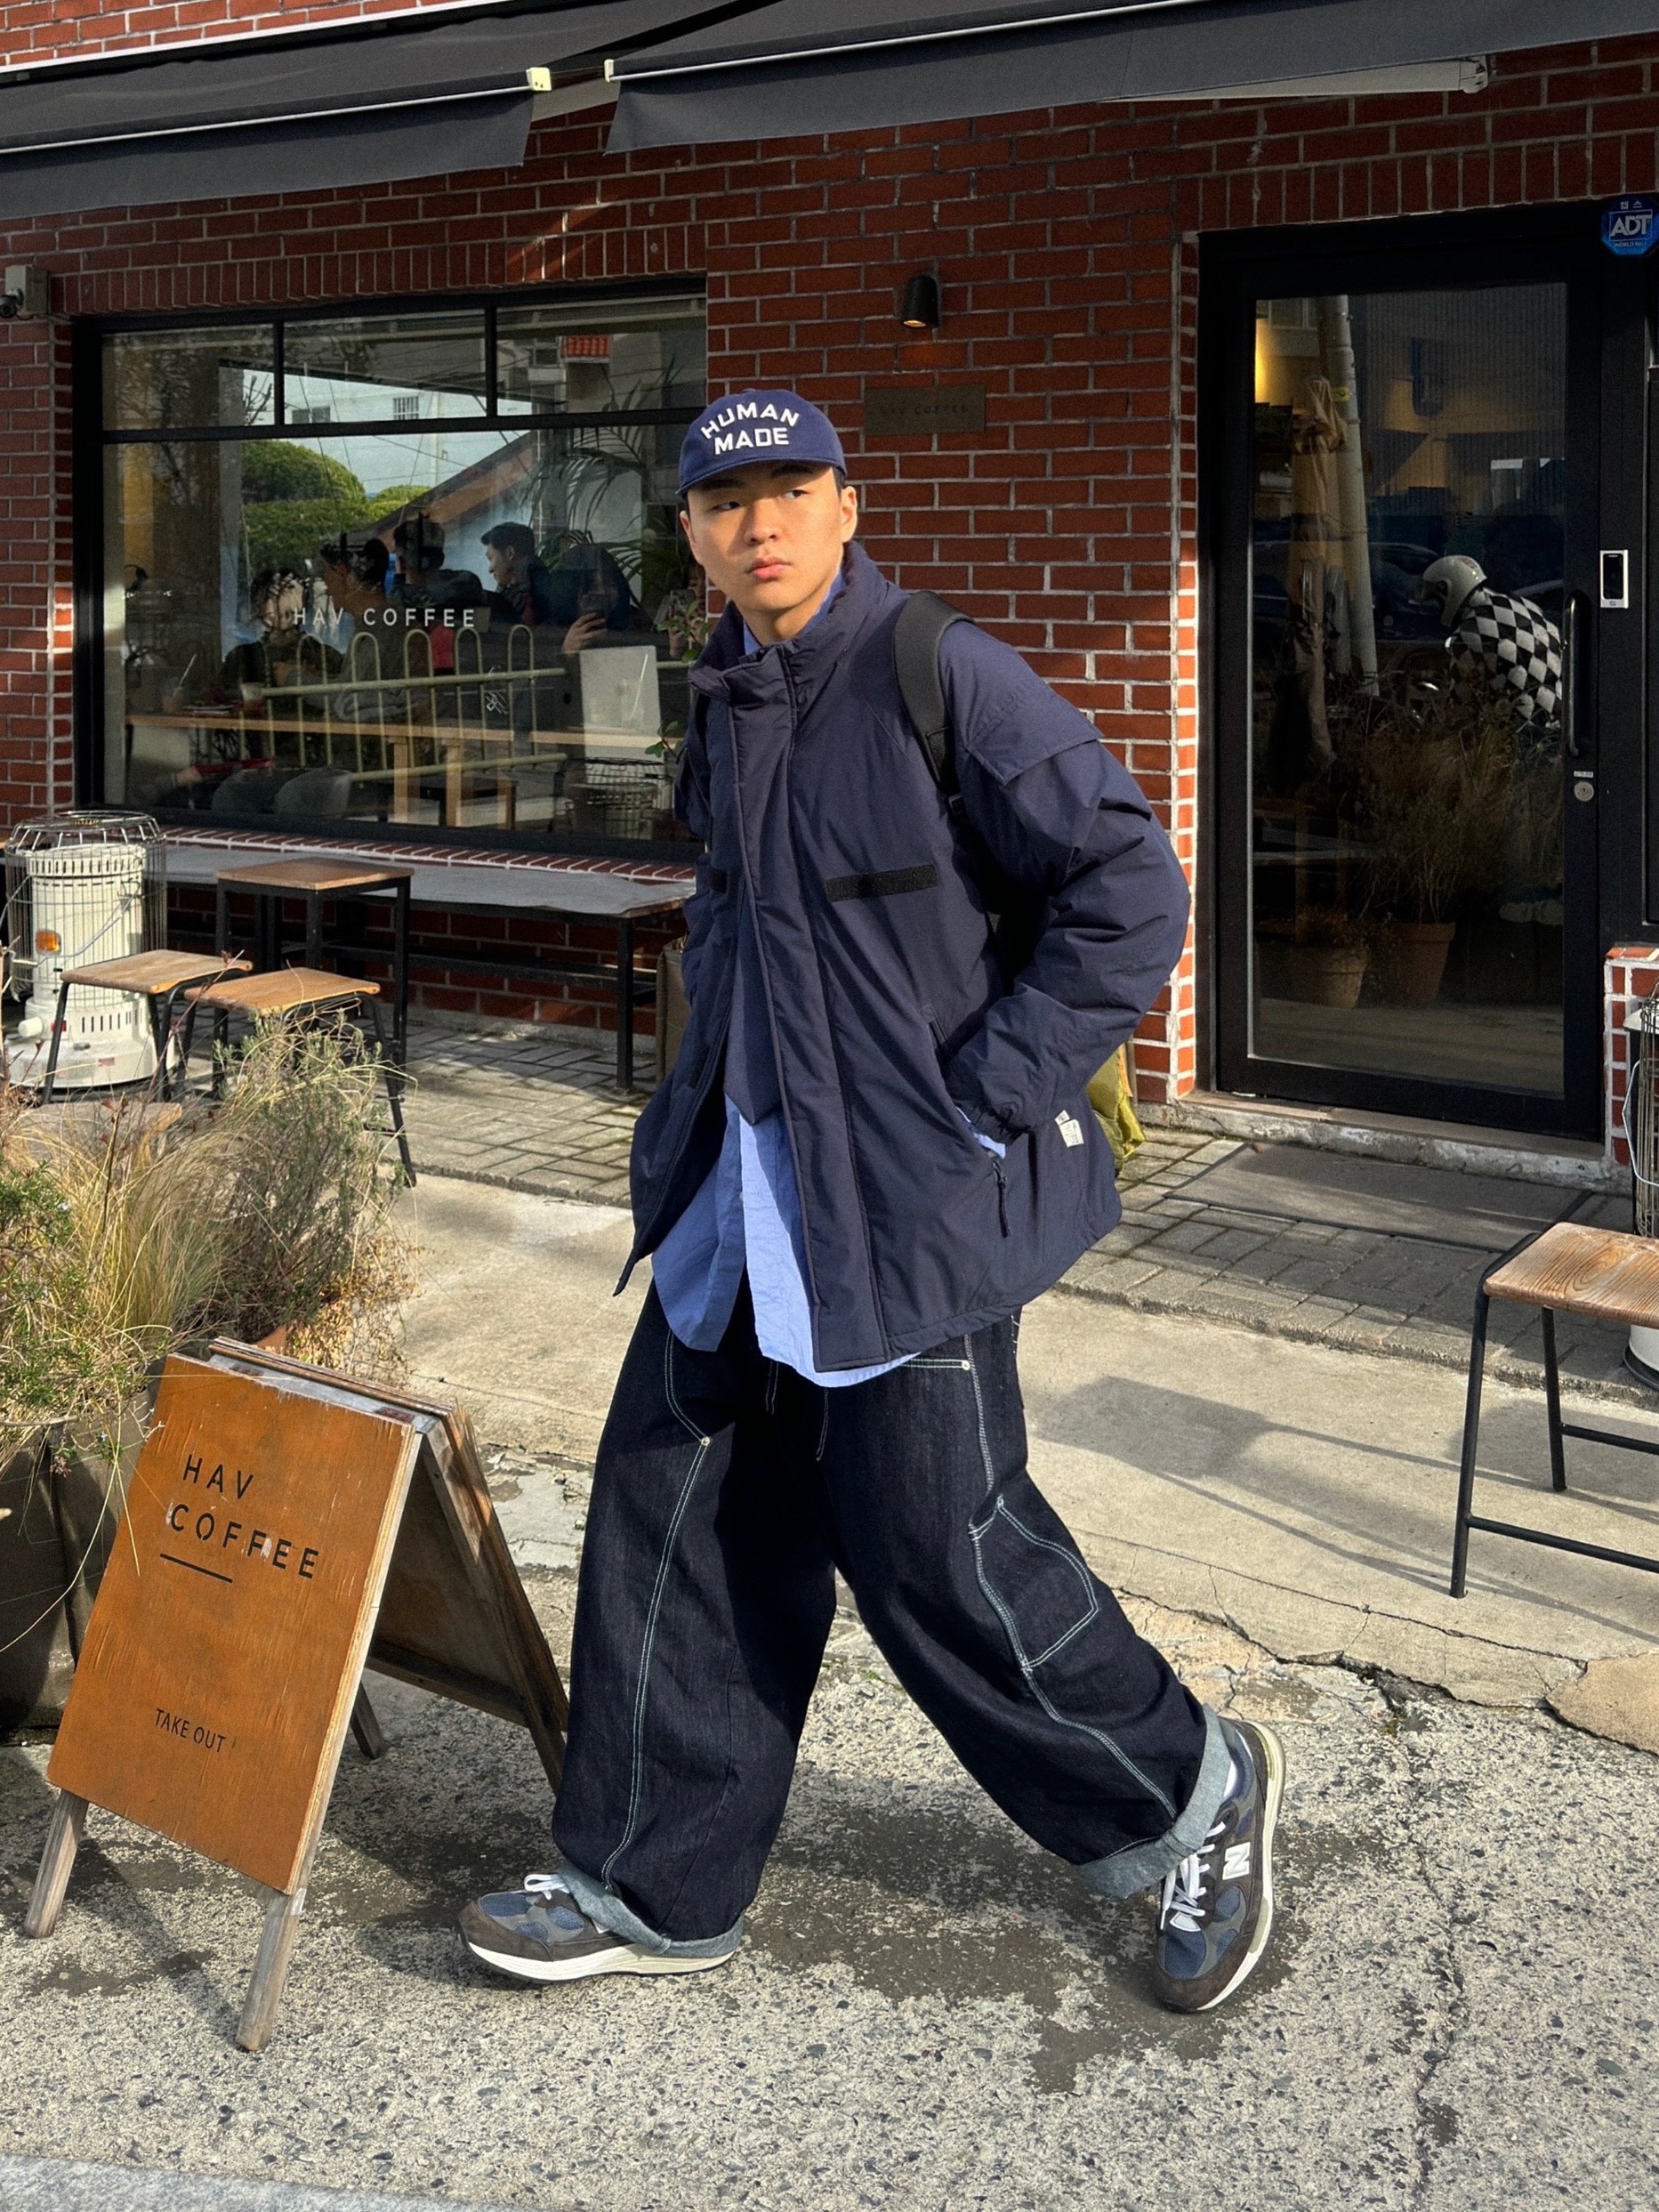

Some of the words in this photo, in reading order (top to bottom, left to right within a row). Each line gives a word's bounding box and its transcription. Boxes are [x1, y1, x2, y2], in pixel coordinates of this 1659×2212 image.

[1610, 214, 1652, 237] ADT
[701, 402, 800, 439] HUMAN
[715, 427, 789, 456] MADE
[294, 607, 344, 626] HAV
[364, 608, 474, 627] COFFEE
[183, 1454, 254, 1499] HAV
[171, 1504, 318, 1578] COFFEE
[156, 1708, 189, 1739] TAKE
[194, 1726, 226, 1753] OUT
[1222, 1842, 1251, 1880] N
